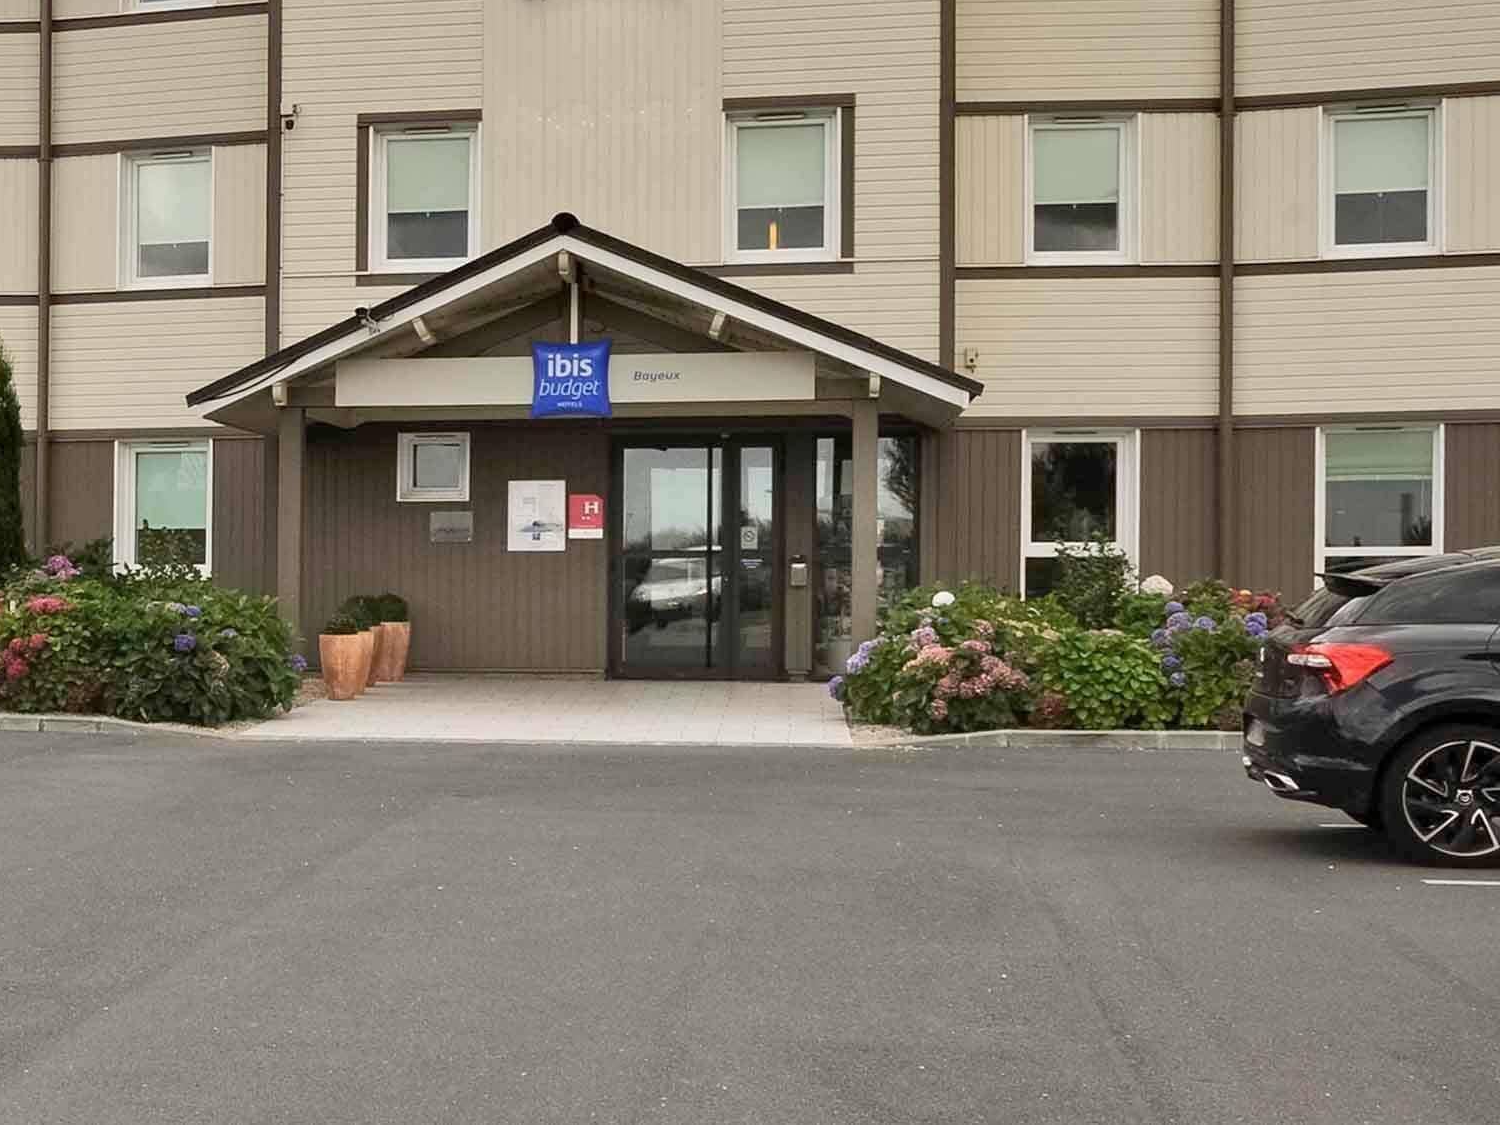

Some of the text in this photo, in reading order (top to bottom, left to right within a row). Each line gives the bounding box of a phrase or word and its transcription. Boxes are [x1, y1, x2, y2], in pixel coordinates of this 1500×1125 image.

[547, 353, 593, 377] ibis
[634, 371, 681, 382] Bayeux
[539, 378, 600, 400] budget
[584, 501, 599, 514] H
